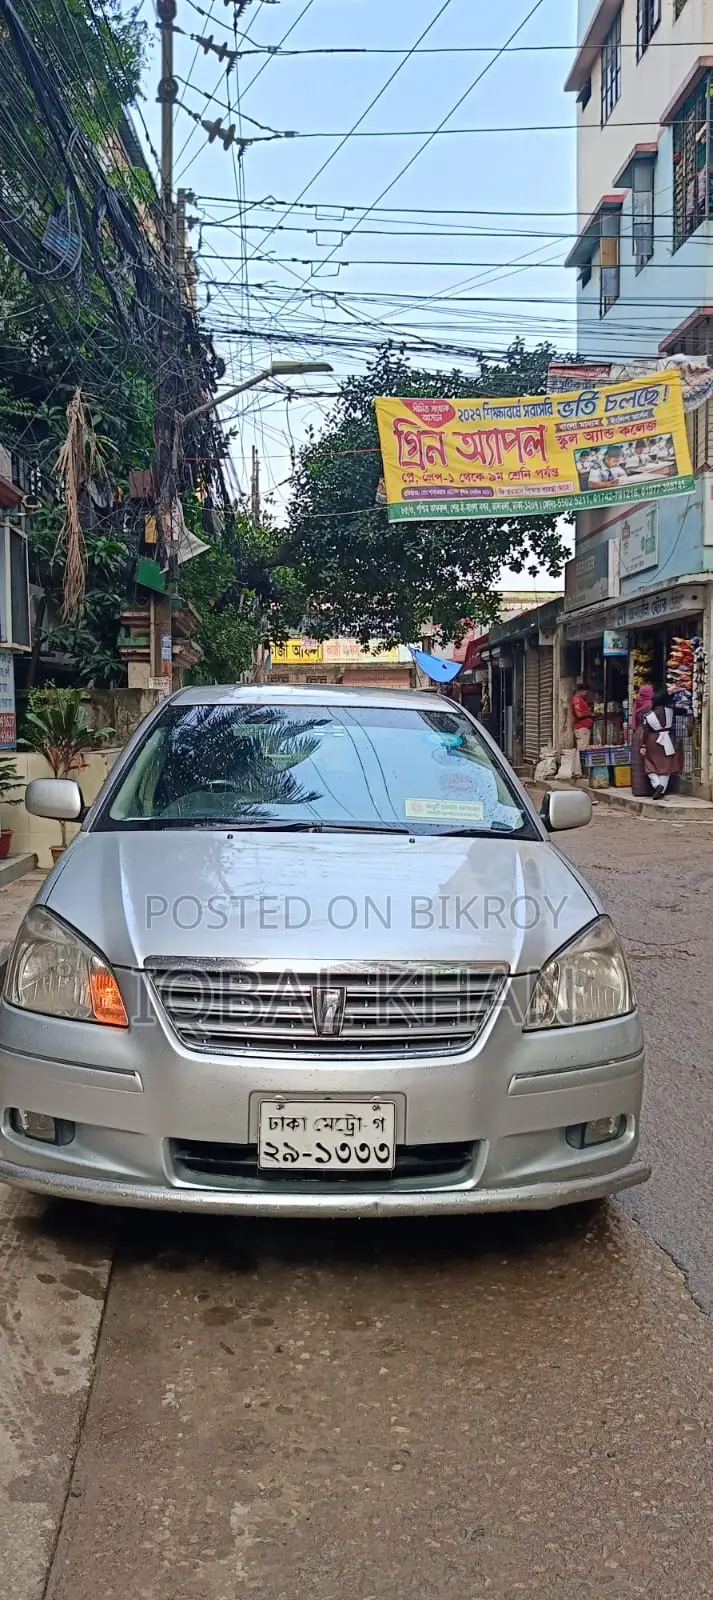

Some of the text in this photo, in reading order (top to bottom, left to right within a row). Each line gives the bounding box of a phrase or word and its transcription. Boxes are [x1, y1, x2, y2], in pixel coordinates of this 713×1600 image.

[523, 396, 553, 418] সরাসরি
[557, 390, 600, 418] ভর্তি
[393, 417, 549, 472] গ্রিন অ্যাপল
[555, 420, 657, 450] স্কুল অ্যান্ড কলেজ
[459, 472, 485, 482] থেকে
[268, 1116, 307, 1132] ঢাকা
[263, 1141, 391, 1164] ২৯-১৩৩৩
